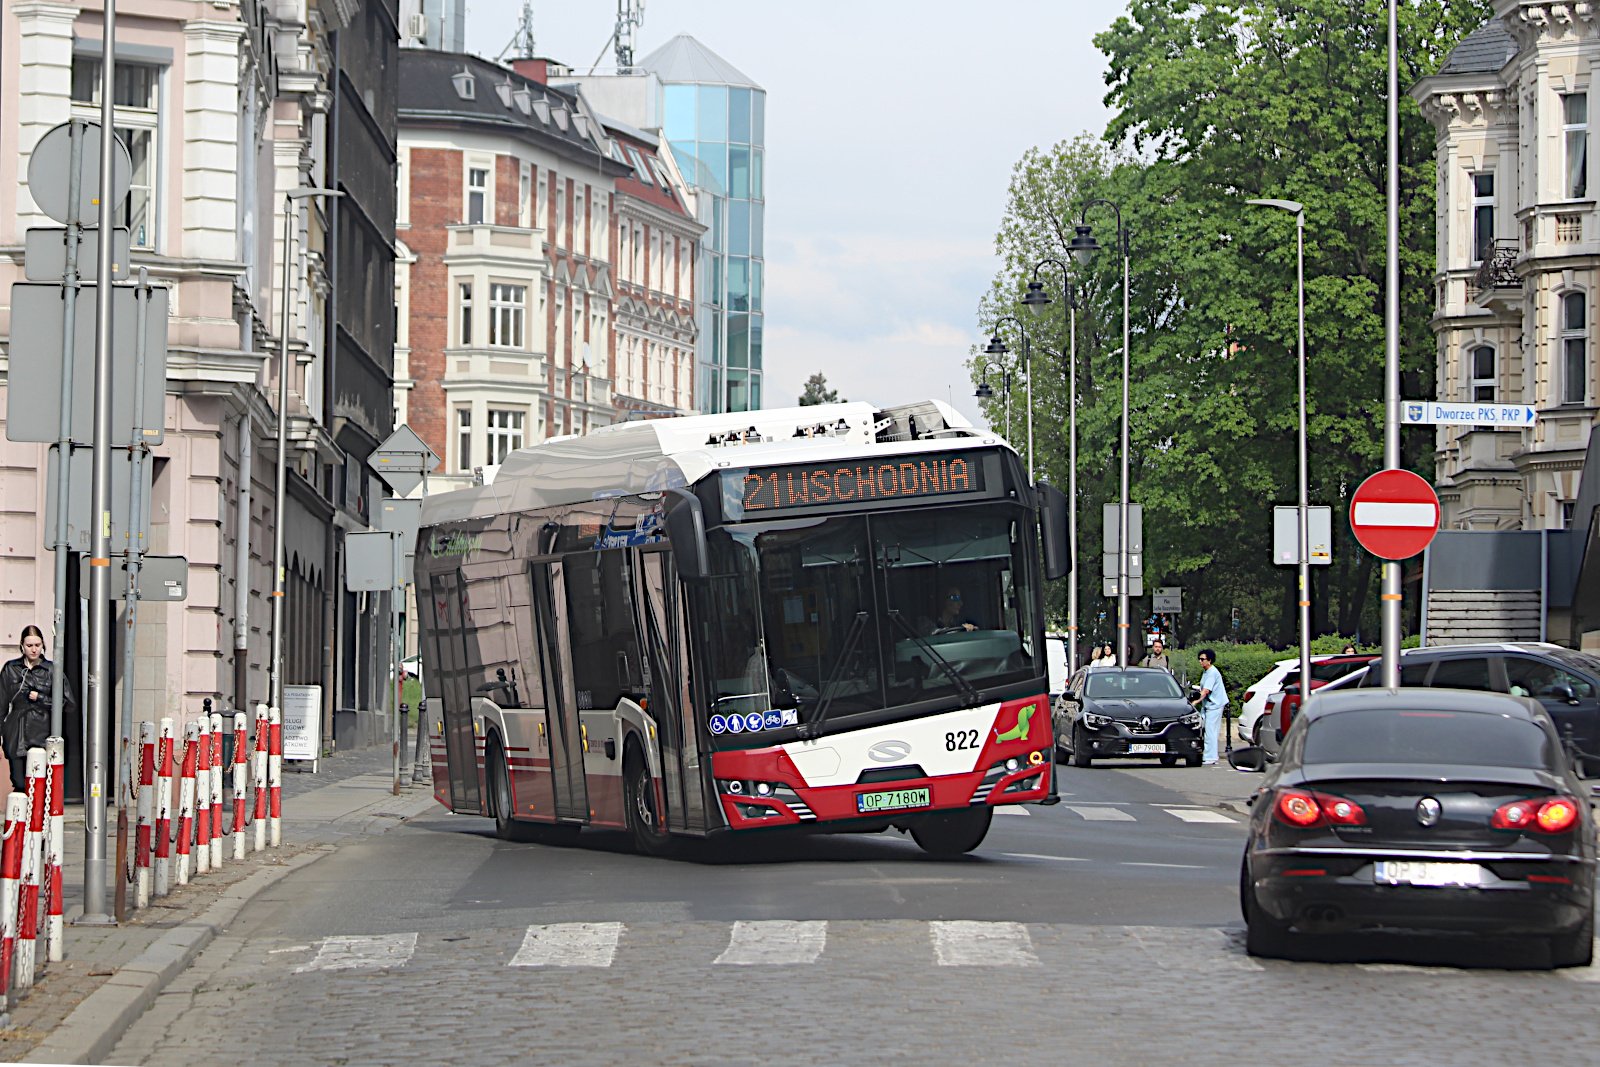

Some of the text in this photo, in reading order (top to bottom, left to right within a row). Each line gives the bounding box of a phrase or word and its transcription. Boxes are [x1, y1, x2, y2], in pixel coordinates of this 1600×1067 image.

[1436, 406, 1520, 423] Dworzec PKS, PKP
[743, 458, 970, 510] 21 WSCHODNIA
[945, 729, 980, 752] 822
[866, 794, 883, 808] OP
[887, 790, 926, 806] 7180W
[1387, 861, 1410, 878] OP
